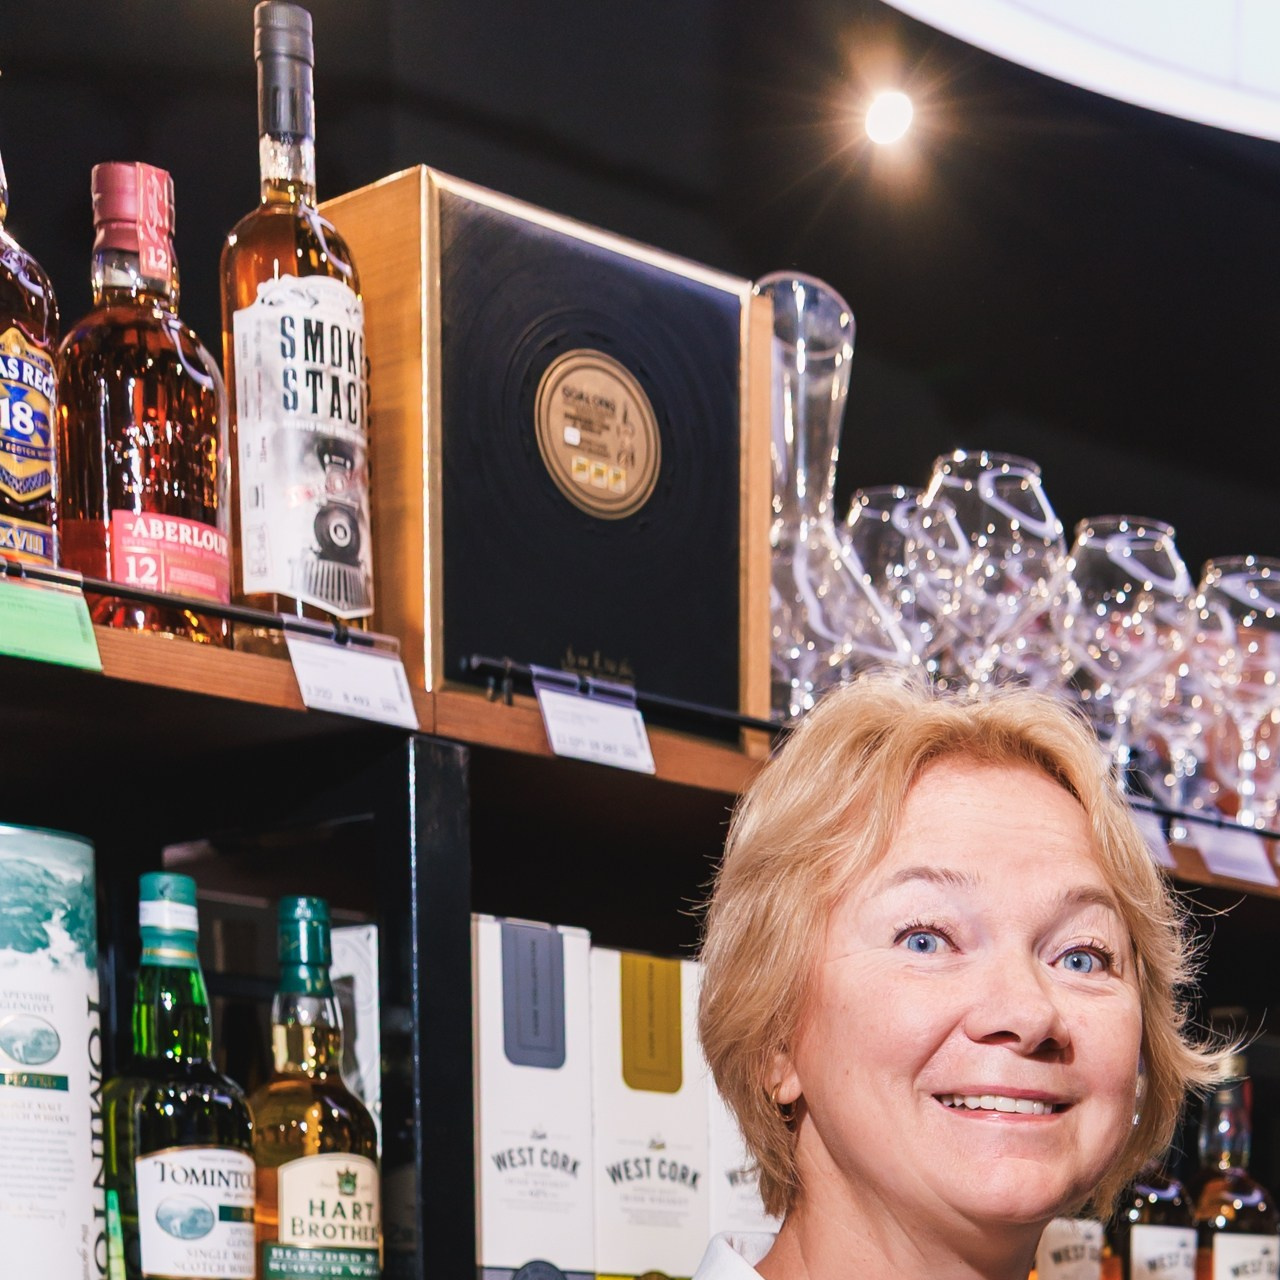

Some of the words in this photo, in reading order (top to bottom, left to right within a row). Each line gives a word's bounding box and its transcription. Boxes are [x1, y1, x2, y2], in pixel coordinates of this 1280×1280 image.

[132, 517, 229, 557] ABERLOUR
[125, 556, 158, 585] 12
[490, 1146, 535, 1174] WEST
[539, 1147, 582, 1180] CORK
[605, 1156, 652, 1186] WEST
[656, 1157, 702, 1193] CORK
[309, 1199, 374, 1222] HART
